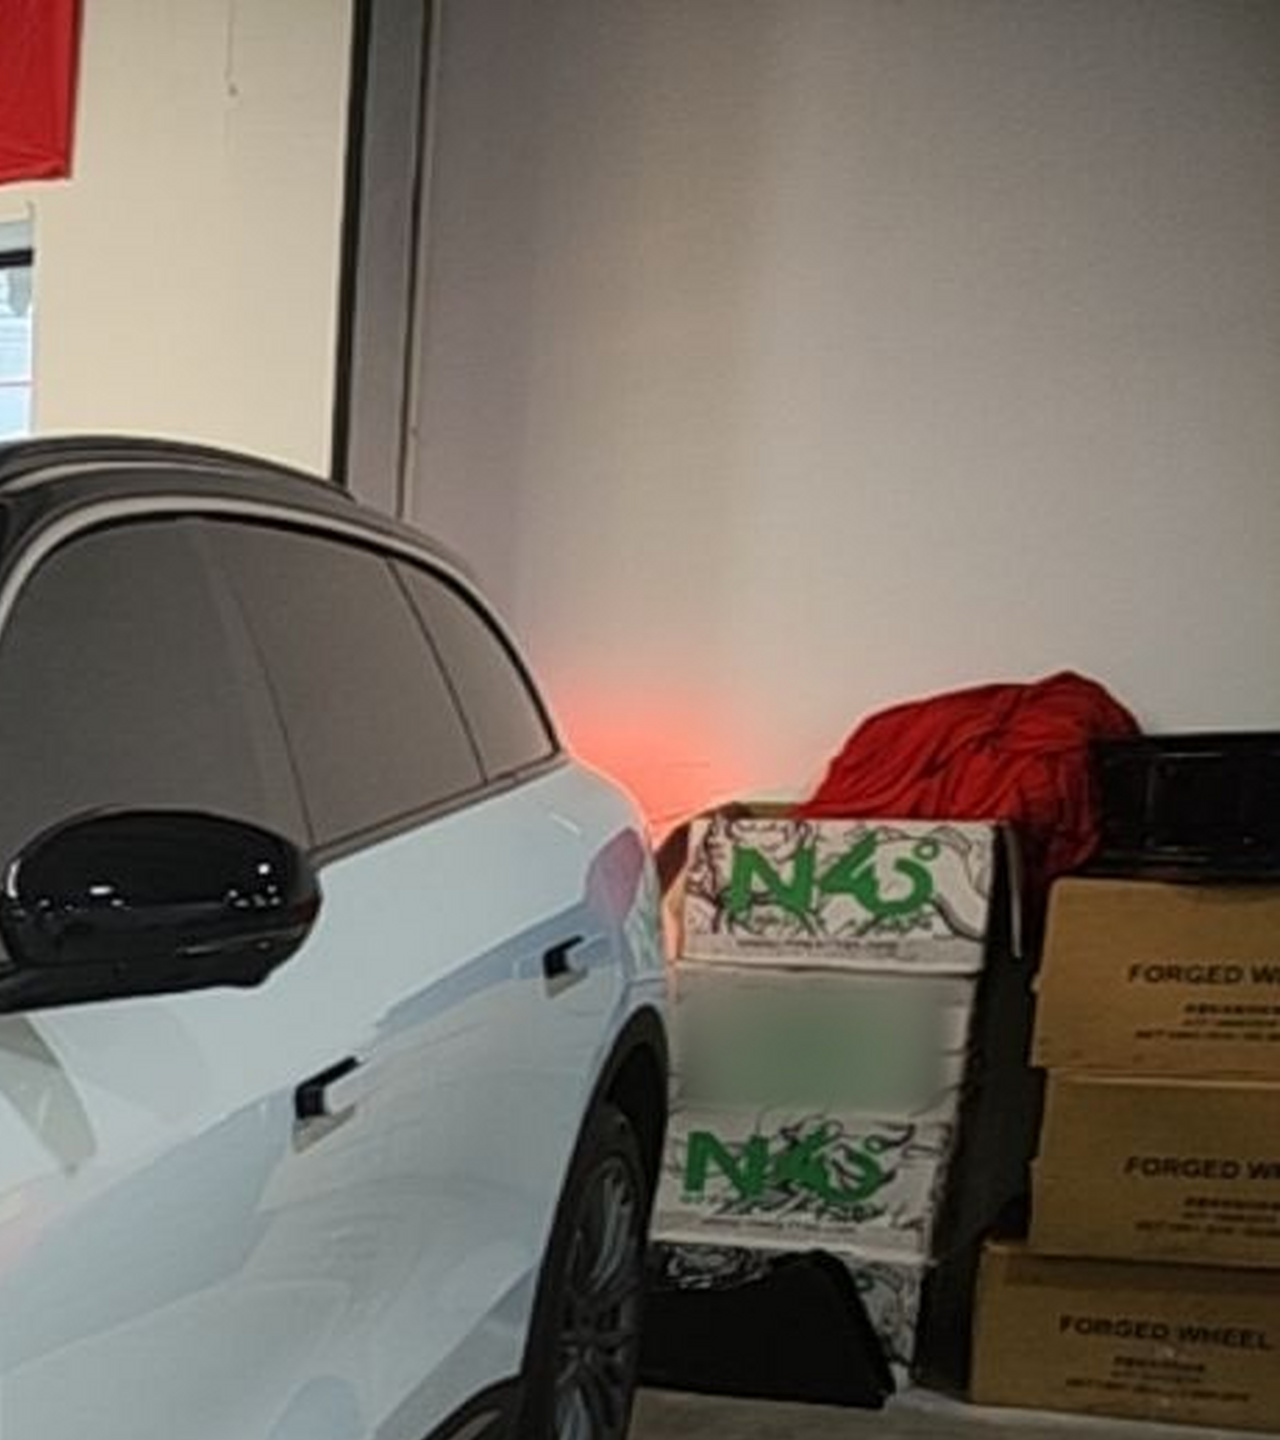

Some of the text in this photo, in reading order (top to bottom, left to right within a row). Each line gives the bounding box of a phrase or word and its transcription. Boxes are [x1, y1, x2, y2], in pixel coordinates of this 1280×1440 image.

[1128, 963, 1243, 984] FORGED
[1124, 1156, 1240, 1180] FORGED
[1060, 1315, 1274, 1351] FORGED WHEEL
